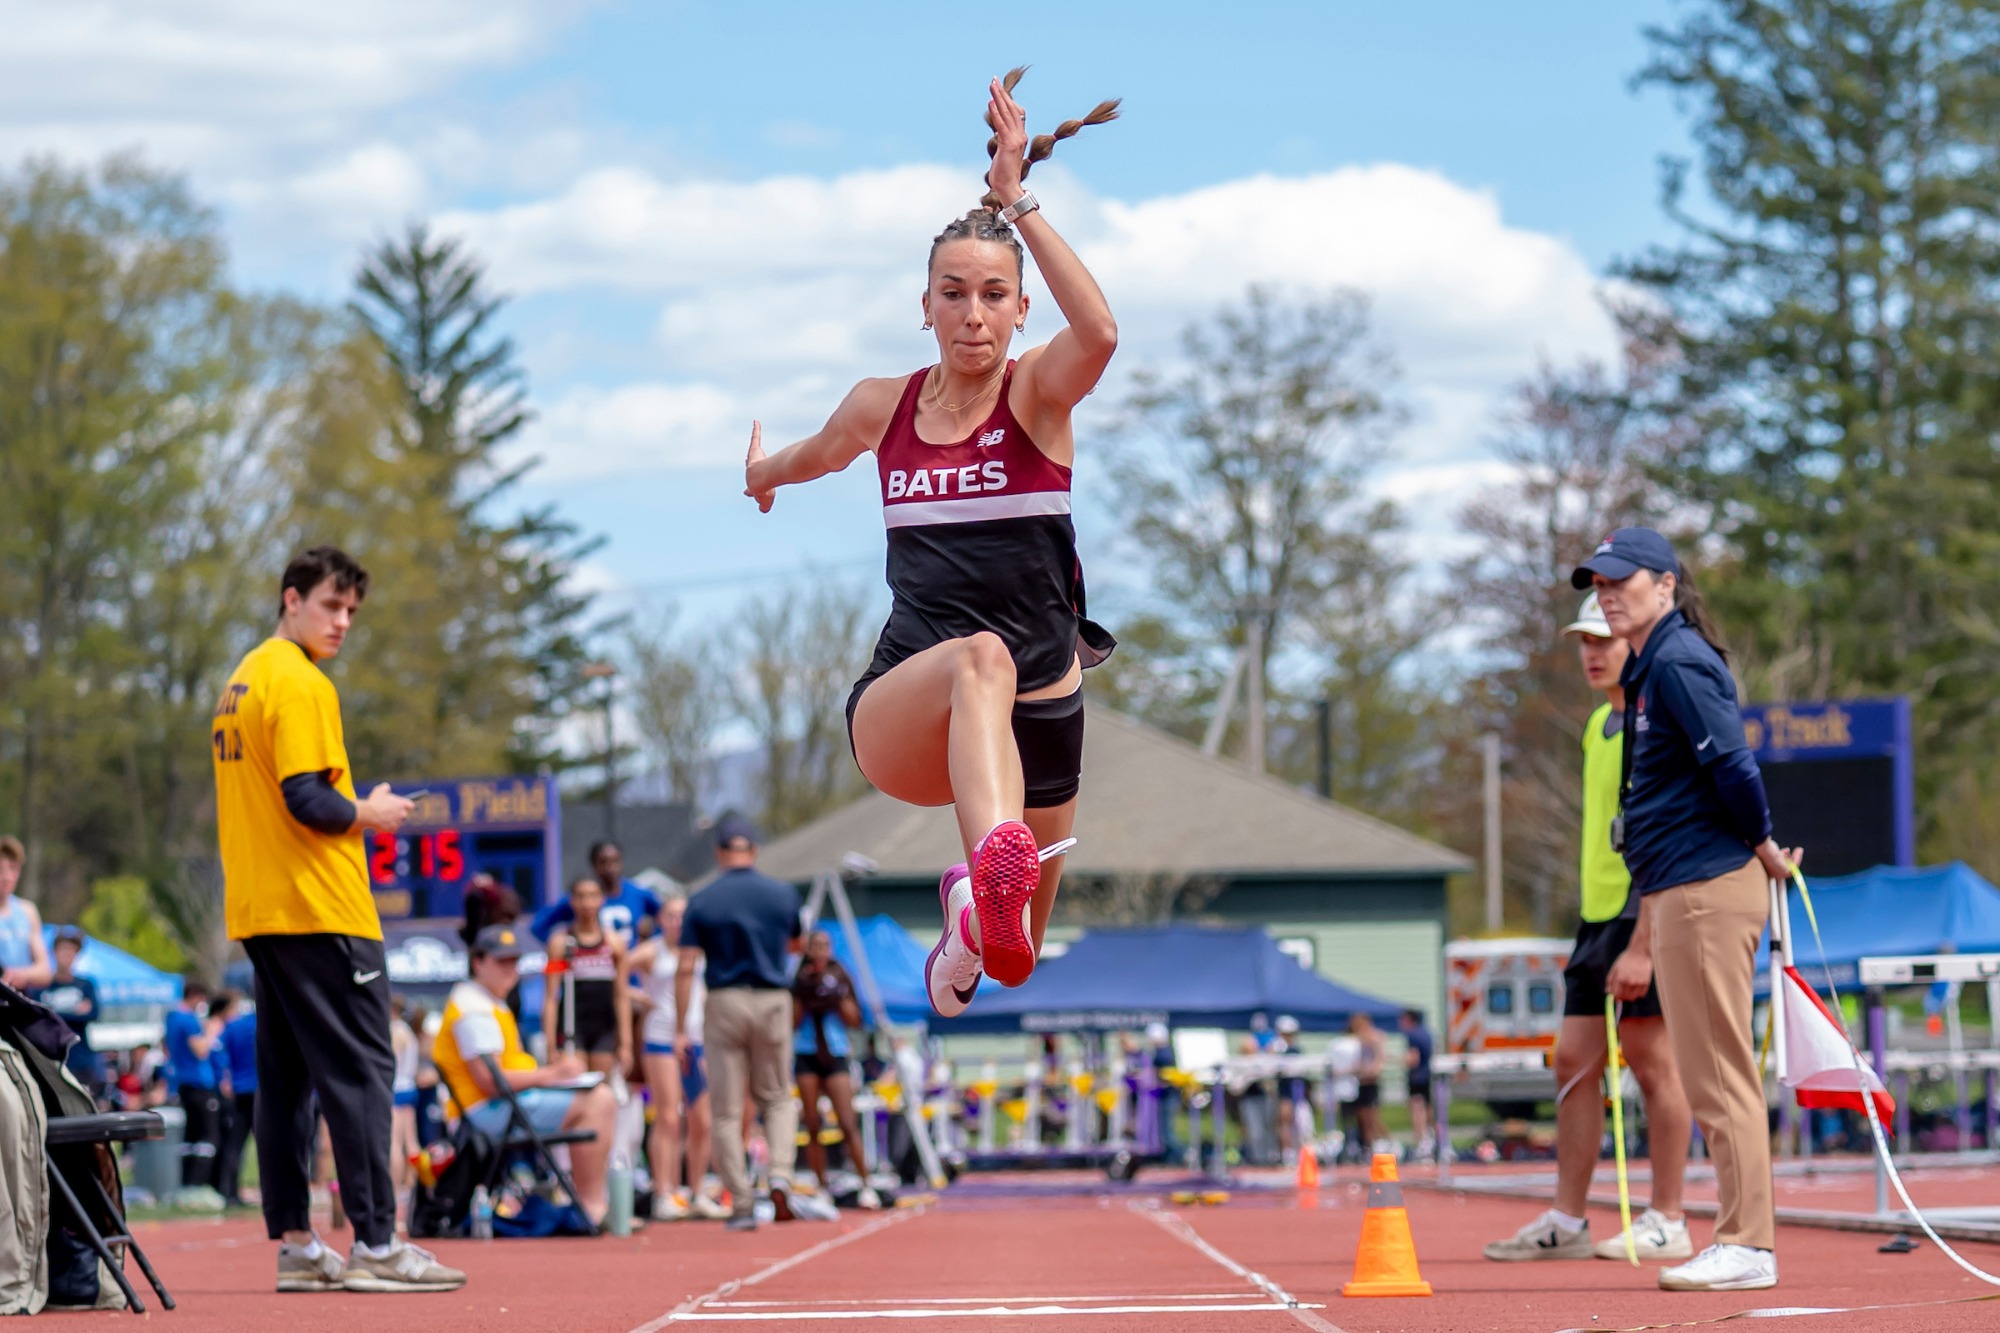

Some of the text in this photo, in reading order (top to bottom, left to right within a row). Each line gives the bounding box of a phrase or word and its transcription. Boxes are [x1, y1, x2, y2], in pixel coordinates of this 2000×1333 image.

[887, 461, 1008, 500] BATES
[1765, 705, 1853, 749] Track
[459, 780, 547, 823] Field
